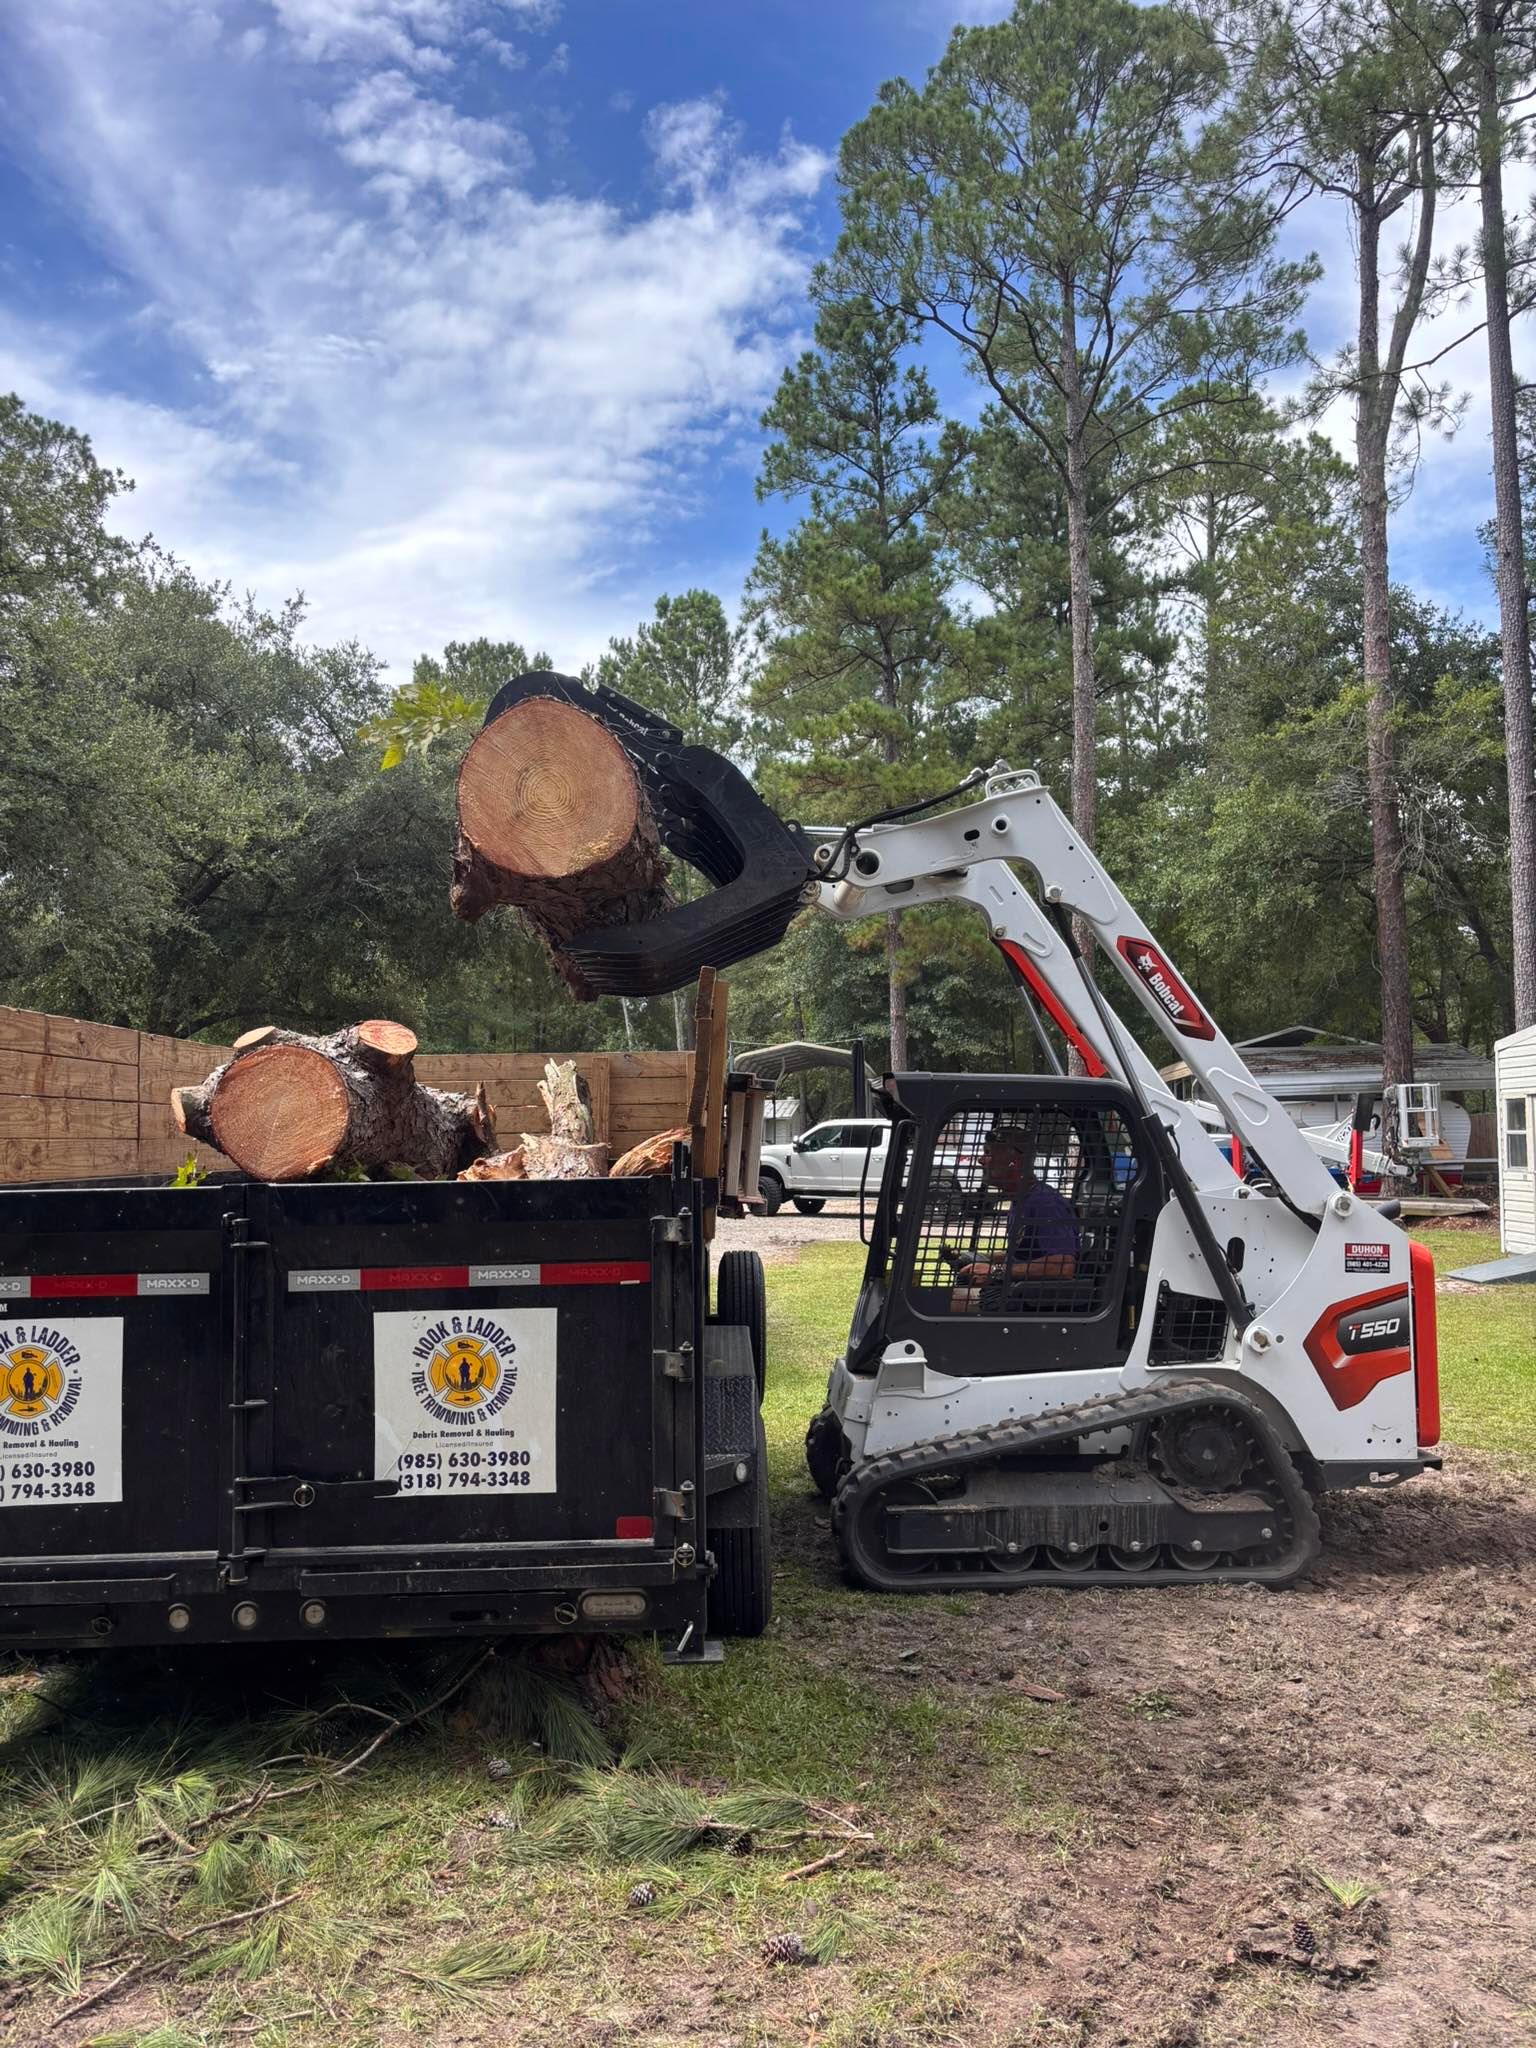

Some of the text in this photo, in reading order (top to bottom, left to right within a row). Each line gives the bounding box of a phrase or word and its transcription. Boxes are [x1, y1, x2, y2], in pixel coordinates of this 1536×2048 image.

[1149, 972, 1185, 1016] Bobcat
[1351, 1244, 1384, 1255] DUHON
[146, 1278, 200, 1289] MAXX-D
[296, 1275, 351, 1285] MAXX-D
[477, 1269, 530, 1280] MAXX-D
[412, 1315, 516, 1360] HOOK & LADDER
[1348, 1317, 1400, 1341] T550
[15, 1326, 27, 1344] &
[30, 1325, 81, 1367] LADDER
[411, 1366, 518, 1426] TREE TRIMMING & REMOVAL
[0, 1376, 82, 1437] MMING & REMOVAL
[412, 1428, 515, 1439] Debris Removal & Hauling
[3, 1438, 80, 1449] Removal & Hauling
[0, 1451, 58, 1460] icensed/Insured
[398, 1451, 531, 1471] (985) 630-3980
[11, 1461, 95, 1479] 630-3980
[11, 1481, 95, 1500] 794-3348
[399, 1471, 531, 1491] (318) 794-3348
